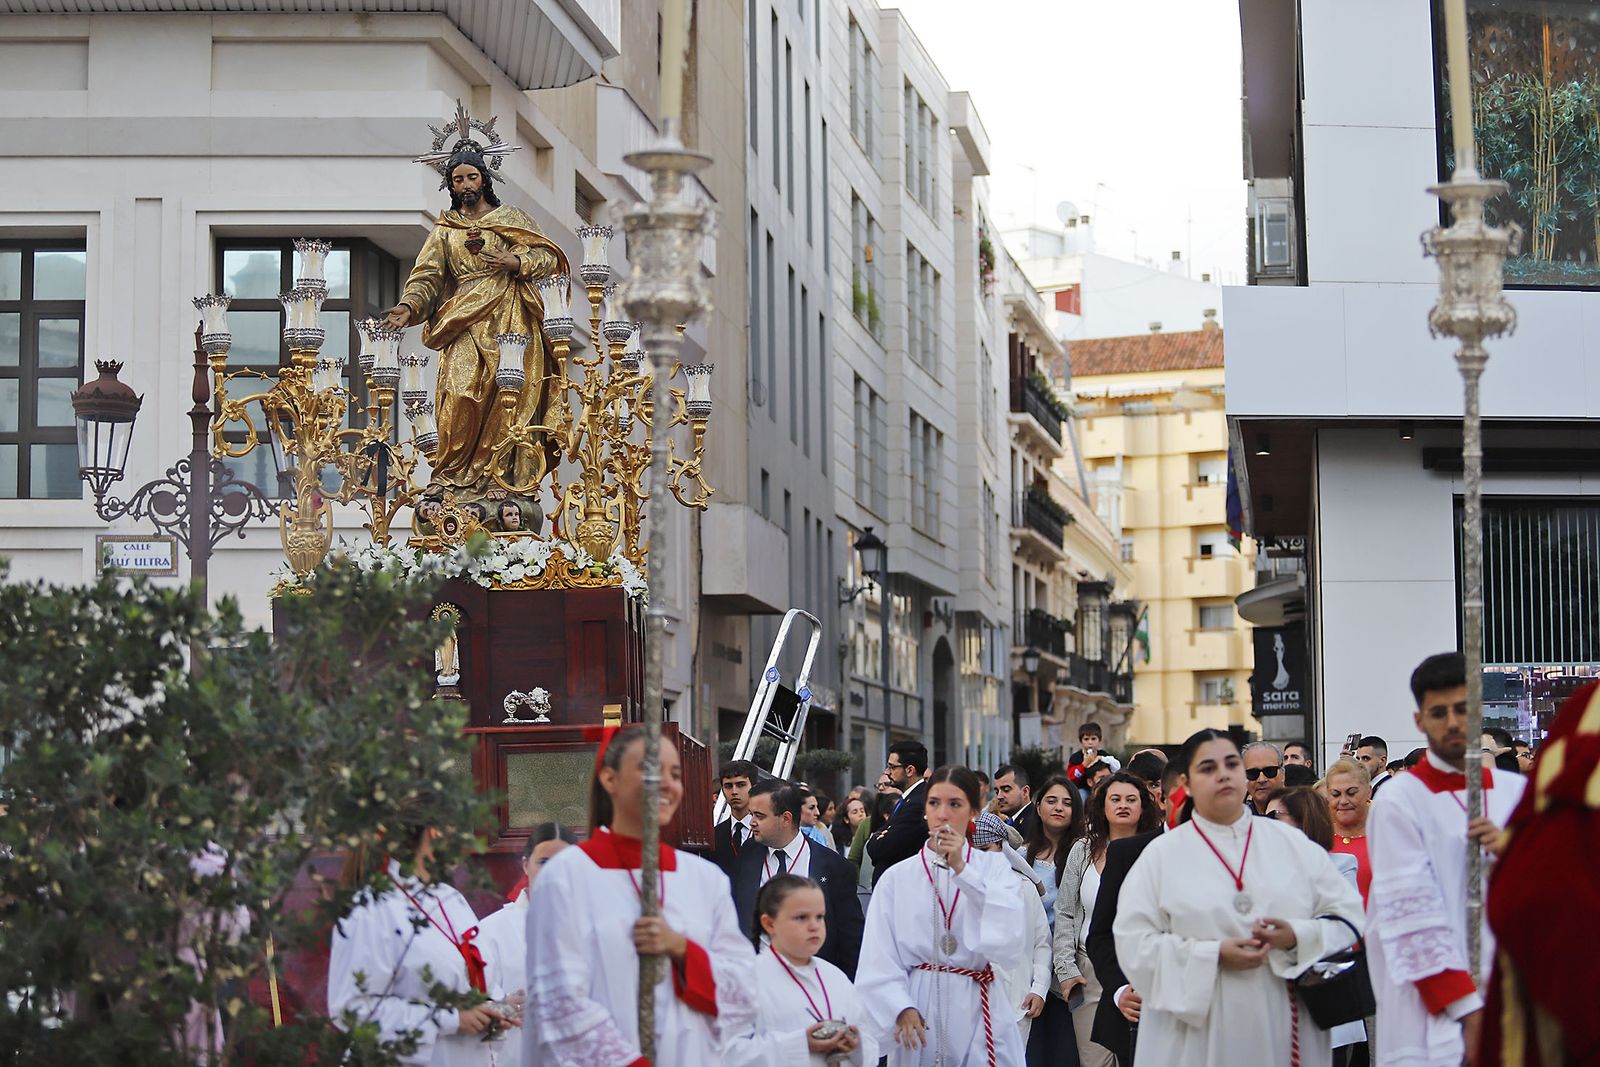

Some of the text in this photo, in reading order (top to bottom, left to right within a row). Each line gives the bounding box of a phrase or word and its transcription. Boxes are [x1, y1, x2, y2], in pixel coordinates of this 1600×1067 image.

[123, 543, 152, 551] CALLE
[134, 557, 170, 567] ULTRA
[1263, 691, 1300, 702] sara
[1263, 702, 1300, 710] merino
